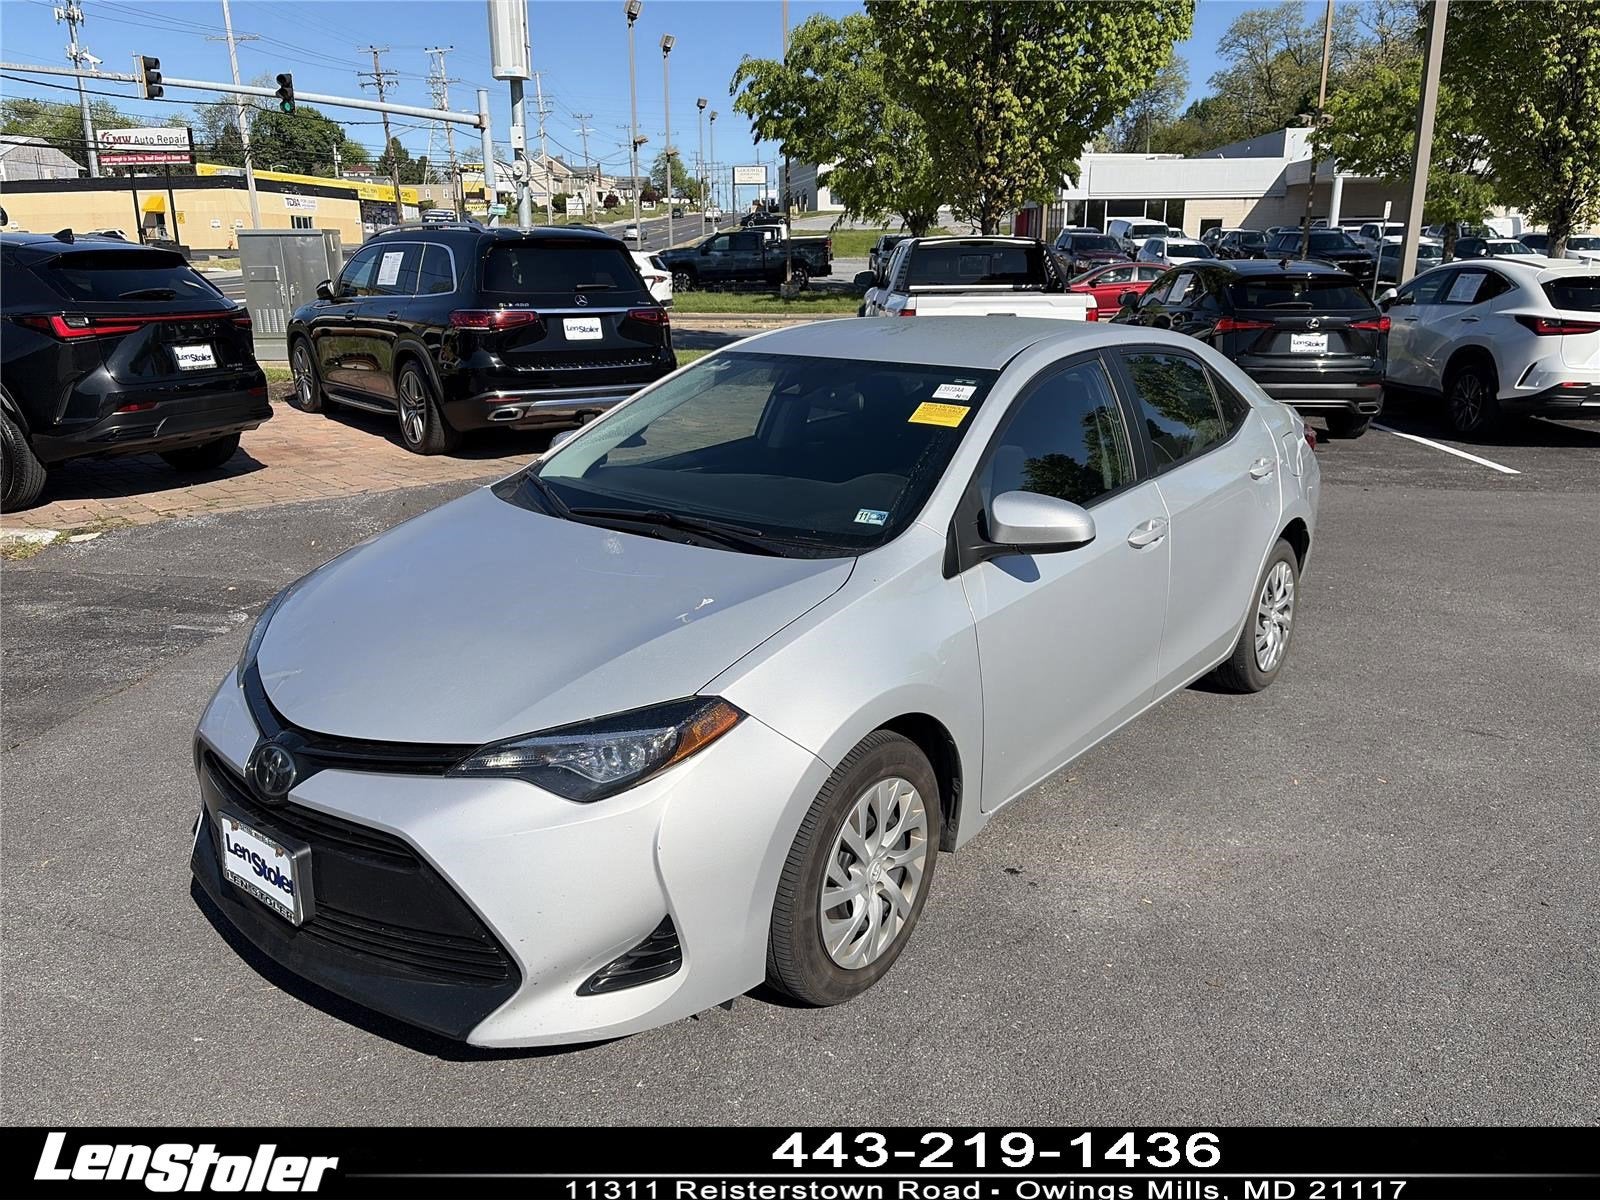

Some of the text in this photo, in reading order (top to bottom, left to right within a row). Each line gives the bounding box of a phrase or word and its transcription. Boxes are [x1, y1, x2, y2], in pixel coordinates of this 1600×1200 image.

[134, 135, 154, 144] Auto
[157, 134, 187, 145] Repair
[566, 325, 600, 334] LenStoler
[176, 353, 212, 362] LenStoler
[225, 832, 295, 897] LenStoler
[226, 870, 295, 921] LEN STOLER
